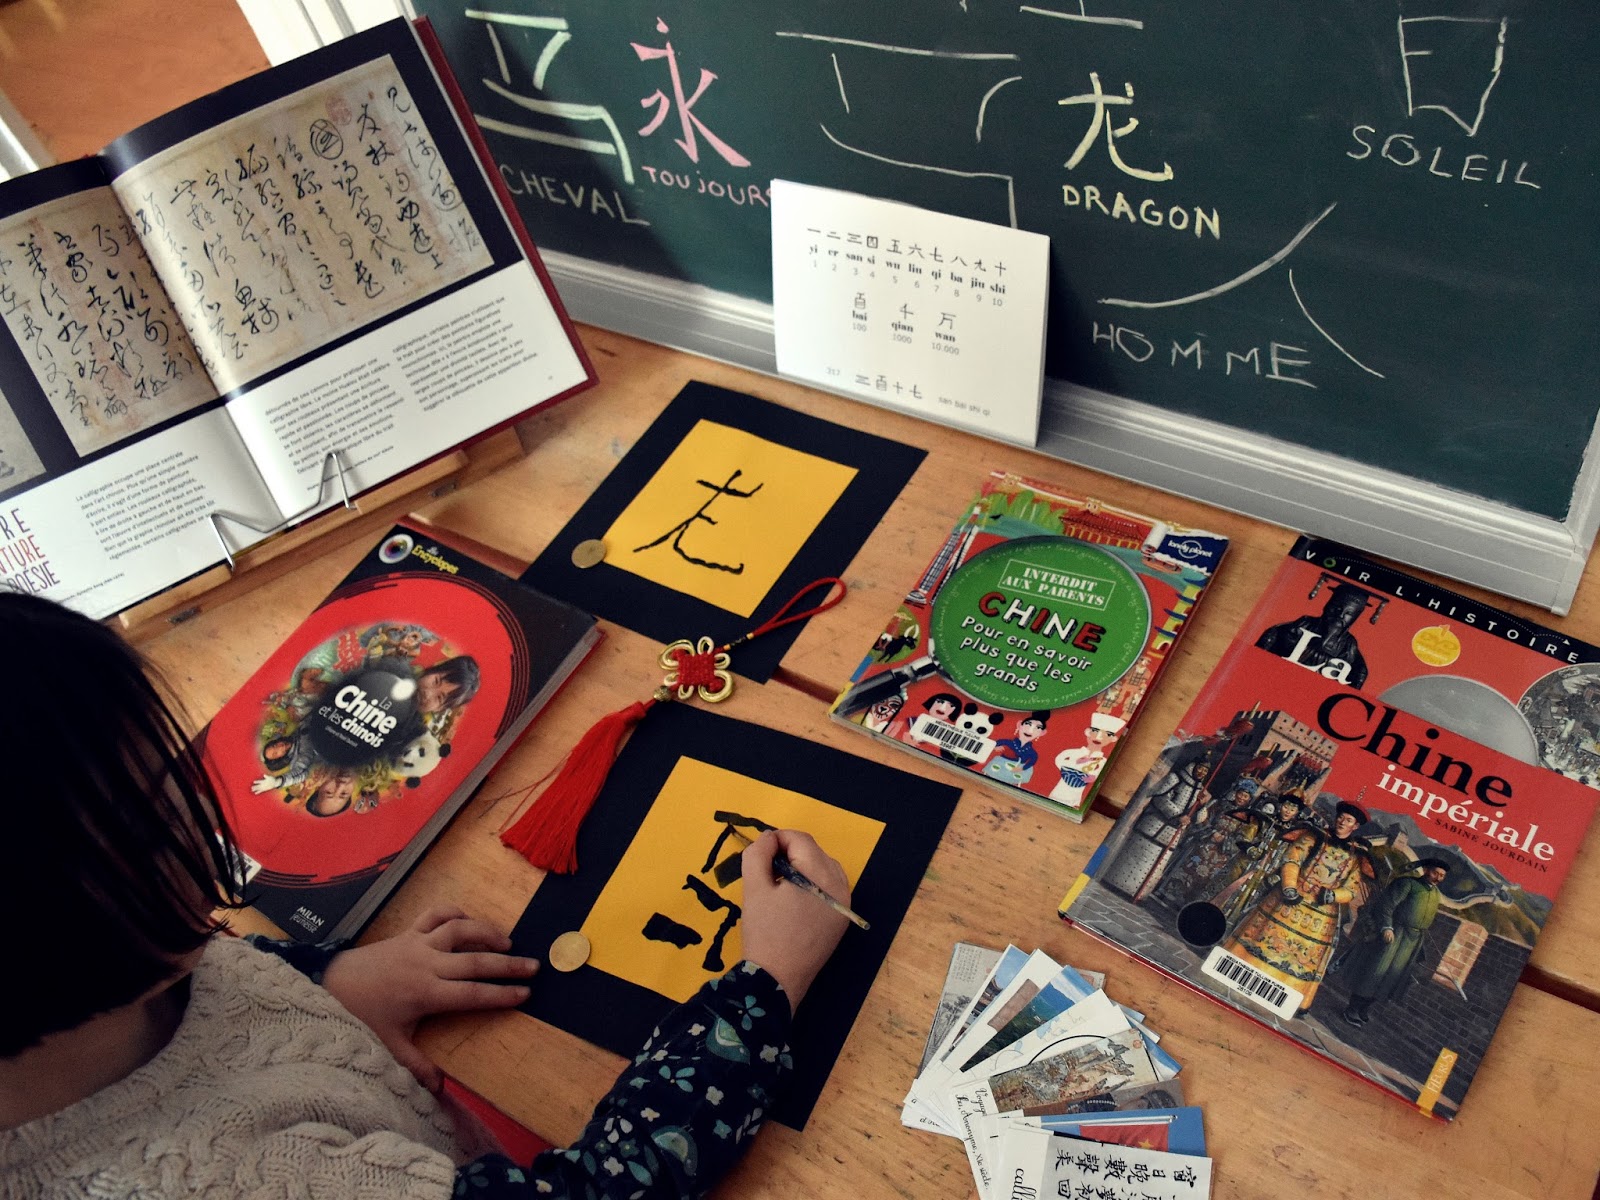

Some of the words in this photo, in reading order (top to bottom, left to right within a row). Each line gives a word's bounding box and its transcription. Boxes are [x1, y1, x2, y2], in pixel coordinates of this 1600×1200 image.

[630, 17, 751, 168] 永
[1058, 72, 1173, 181] 龙
[1346, 124, 1542, 189] SOLEIL
[501, 163, 650, 226] CHEVAL
[641, 165, 771, 207] TOUJOUR
[1062, 183, 1221, 240] DRAGON
[846, 253, 863, 262] san
[867, 255, 875, 264] si
[931, 269, 941, 280] qi
[950, 272, 963, 283] ba
[990, 283, 1006, 294] shi
[852, 310, 867, 321] bai
[891, 320, 914, 333] qian
[935, 332, 956, 342] wan
[992, 298, 1003, 307] 10
[853, 322, 867, 332] 100
[892, 333, 912, 344] 1000
[1092, 321, 1318, 389] HOMME
[969, 404, 981, 414] shi
[1167, 539, 1189, 552] lonely
[1188, 546, 1212, 557] planet
[1002, 576, 1032, 590] AUX
[1038, 583, 1105, 606] PARENTS
[1023, 567, 1098, 592] INTERDIT
[979, 591, 1106, 653] CHINE
[1305, 550, 1371, 582] VOIR
[1395, 585, 1580, 664] L'HISTOIRE
[960, 637, 1000, 658] plus
[1005, 653, 1038, 671] que
[1043, 663, 1073, 683] les
[961, 616, 1004, 640] Pour
[1007, 636, 1030, 650] en
[1034, 645, 1092, 670] savoir
[1282, 627, 1353, 686] La
[974, 663, 1039, 692] grands
[318, 705, 332, 718] et
[328, 708, 344, 726] les
[341, 717, 384, 748] chinois
[334, 684, 398, 735] Chine
[378, 696, 393, 711] La
[1316, 692, 1513, 808] Chine
[1376, 764, 1555, 861] impériale
[1434, 818, 1479, 843] SABINE
[1482, 841, 1549, 873] JOURDAIN
[296, 906, 324, 925] MILAN
